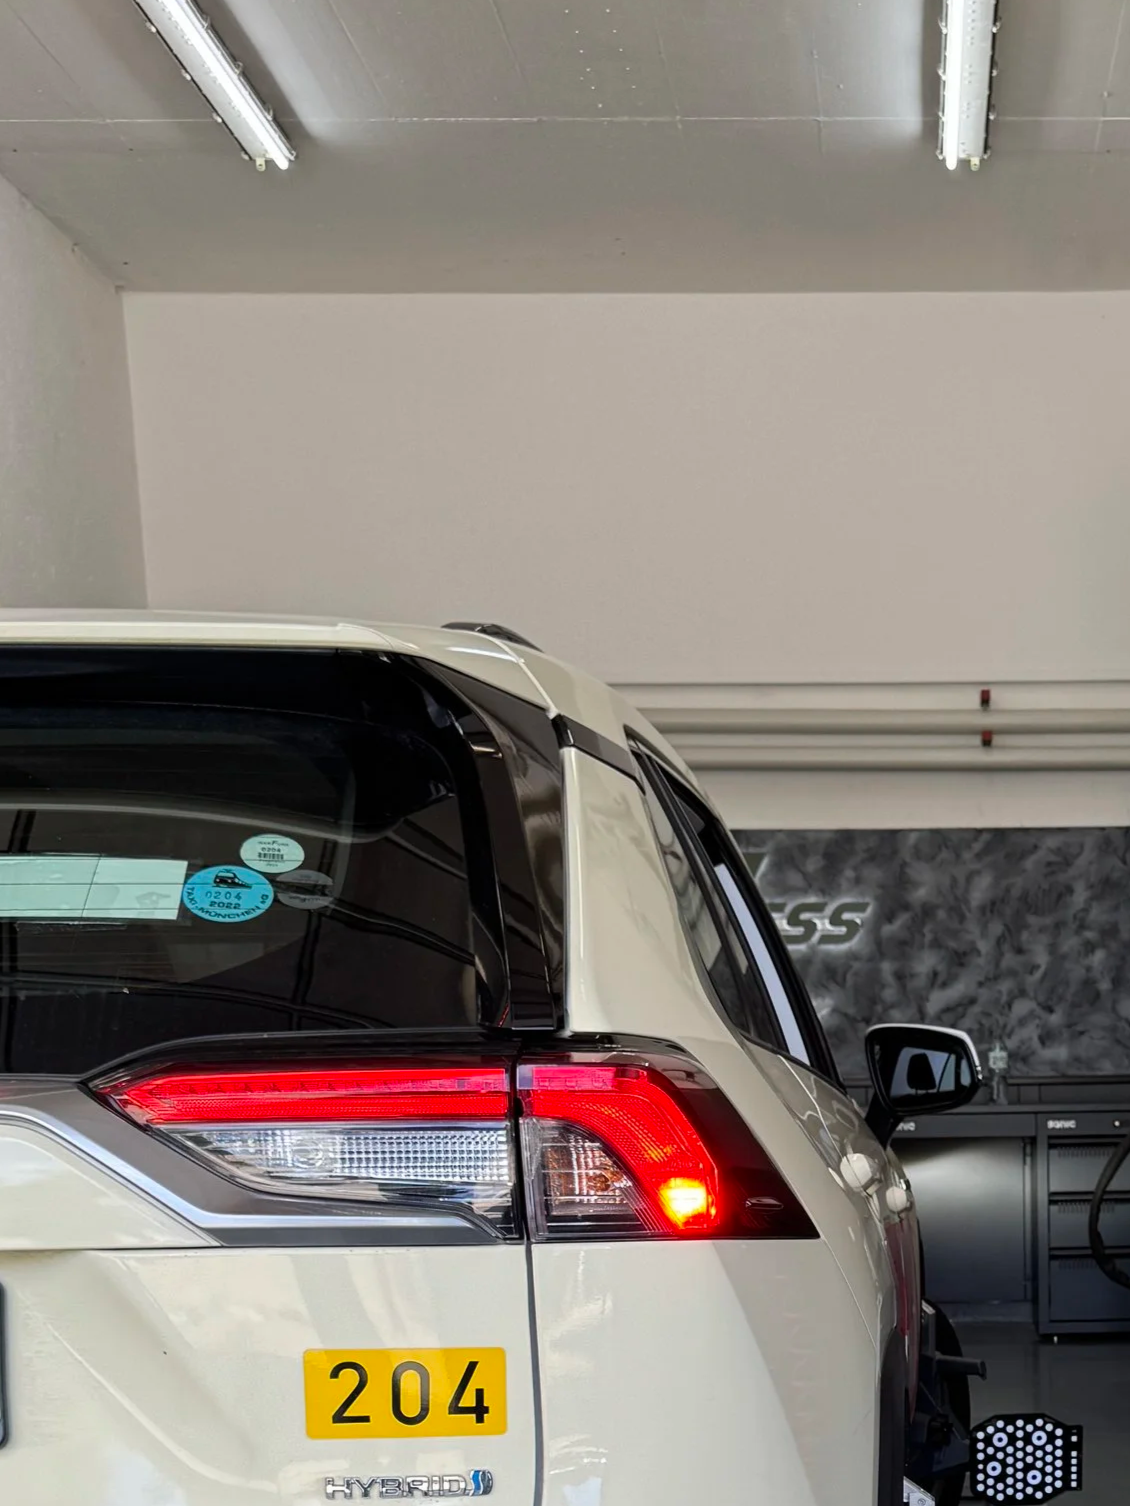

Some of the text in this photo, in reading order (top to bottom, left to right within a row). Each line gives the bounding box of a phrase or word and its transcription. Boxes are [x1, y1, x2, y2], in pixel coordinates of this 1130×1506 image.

[205, 891, 242, 901] 0204
[209, 901, 241, 910] 2022
[330, 1361, 489, 1425] 204
[325, 1476, 467, 1500] HYBRID
